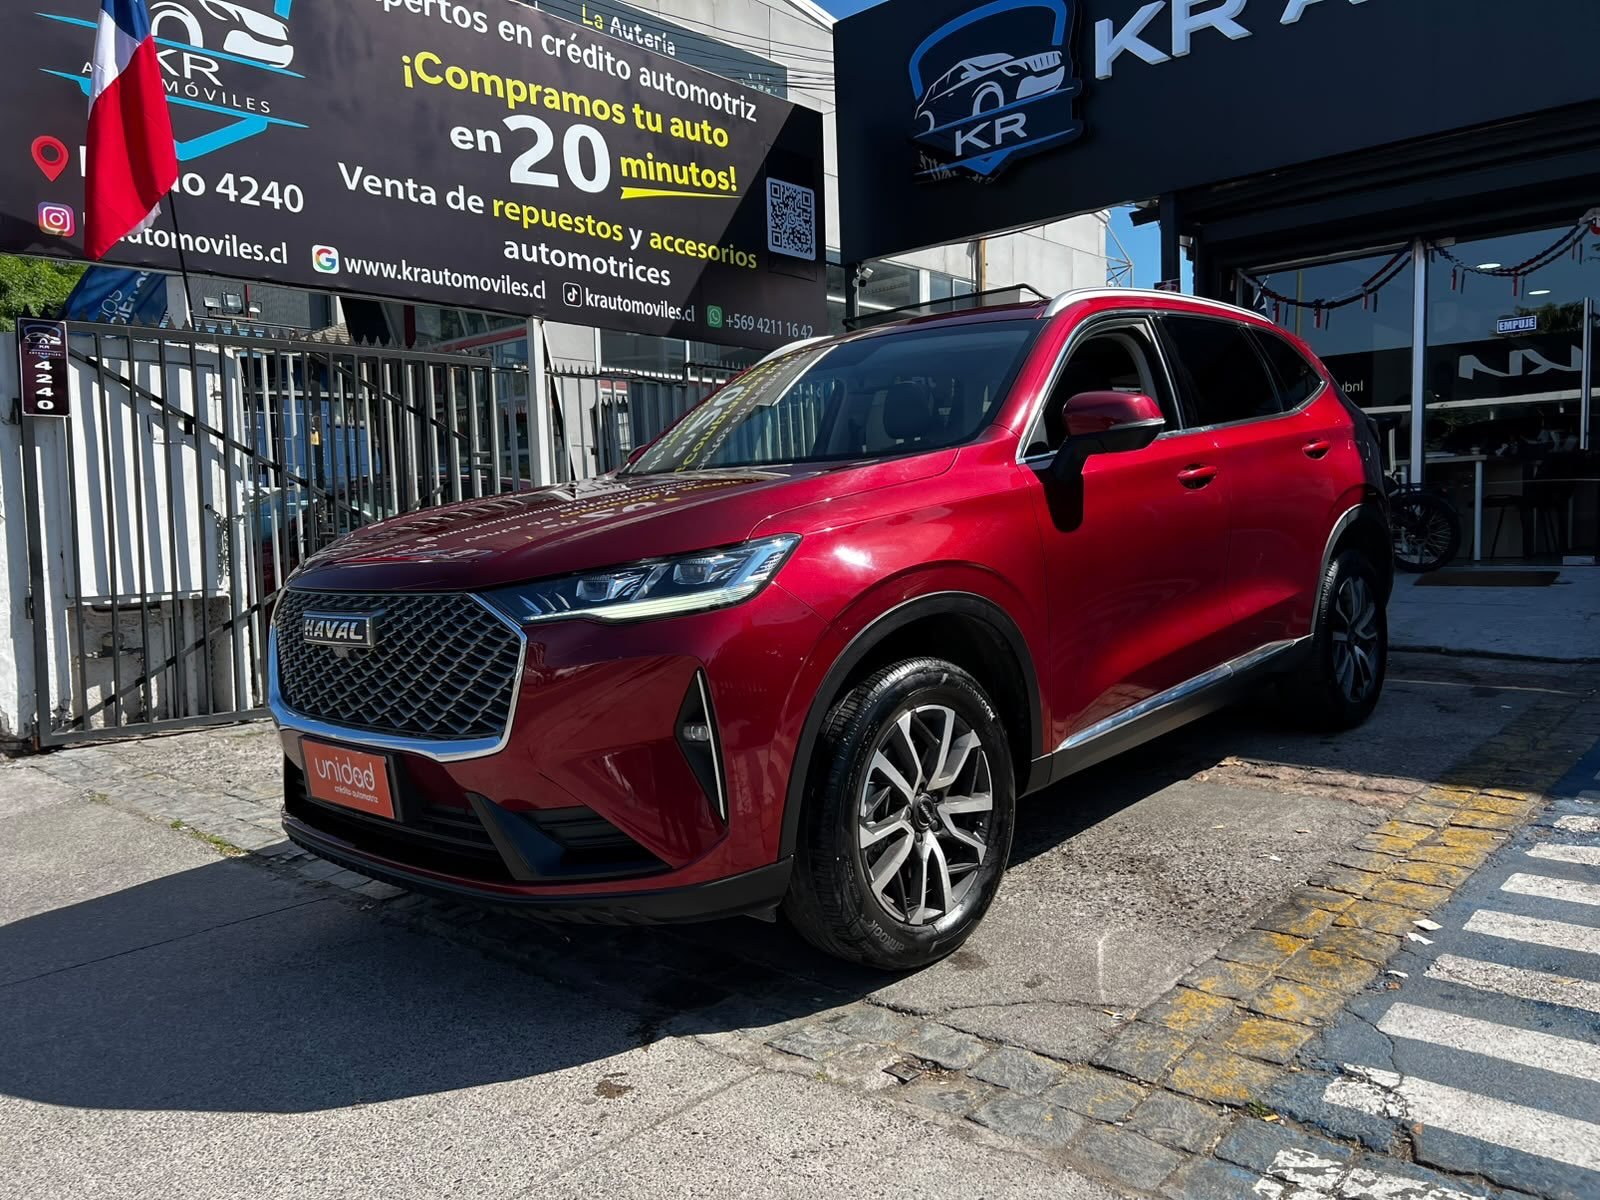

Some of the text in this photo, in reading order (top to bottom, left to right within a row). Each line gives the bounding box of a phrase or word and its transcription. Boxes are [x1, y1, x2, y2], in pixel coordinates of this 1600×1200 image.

[582, 4, 676, 57] La Autería
[1095, 0, 1253, 80] KR
[377, 0, 488, 33] pertos
[498, 20, 533, 49] en
[541, 33, 631, 80] crédito
[639, 66, 757, 122] automotriz
[82, 61, 272, 114] AMÓVILES
[401, 51, 729, 148] ¡Compramos tu auto
[449, 114, 737, 194] en 20 minutos!
[955, 112, 1027, 157] KR
[215, 172, 304, 213] 4240
[338, 161, 758, 269] Venta de repuestos y accesorios
[344, 257, 546, 300] www.krautomoviles.cl
[503, 240, 671, 286] automotrices
[585, 287, 695, 323] krautomoviles.cl
[726, 313, 814, 339] +569 4211 16 42
[1499, 318, 1535, 331] EMPUJE
[34, 360, 54, 410] 4240
[304, 618, 364, 640] HAVAL
[314, 756, 375, 791] unidad
